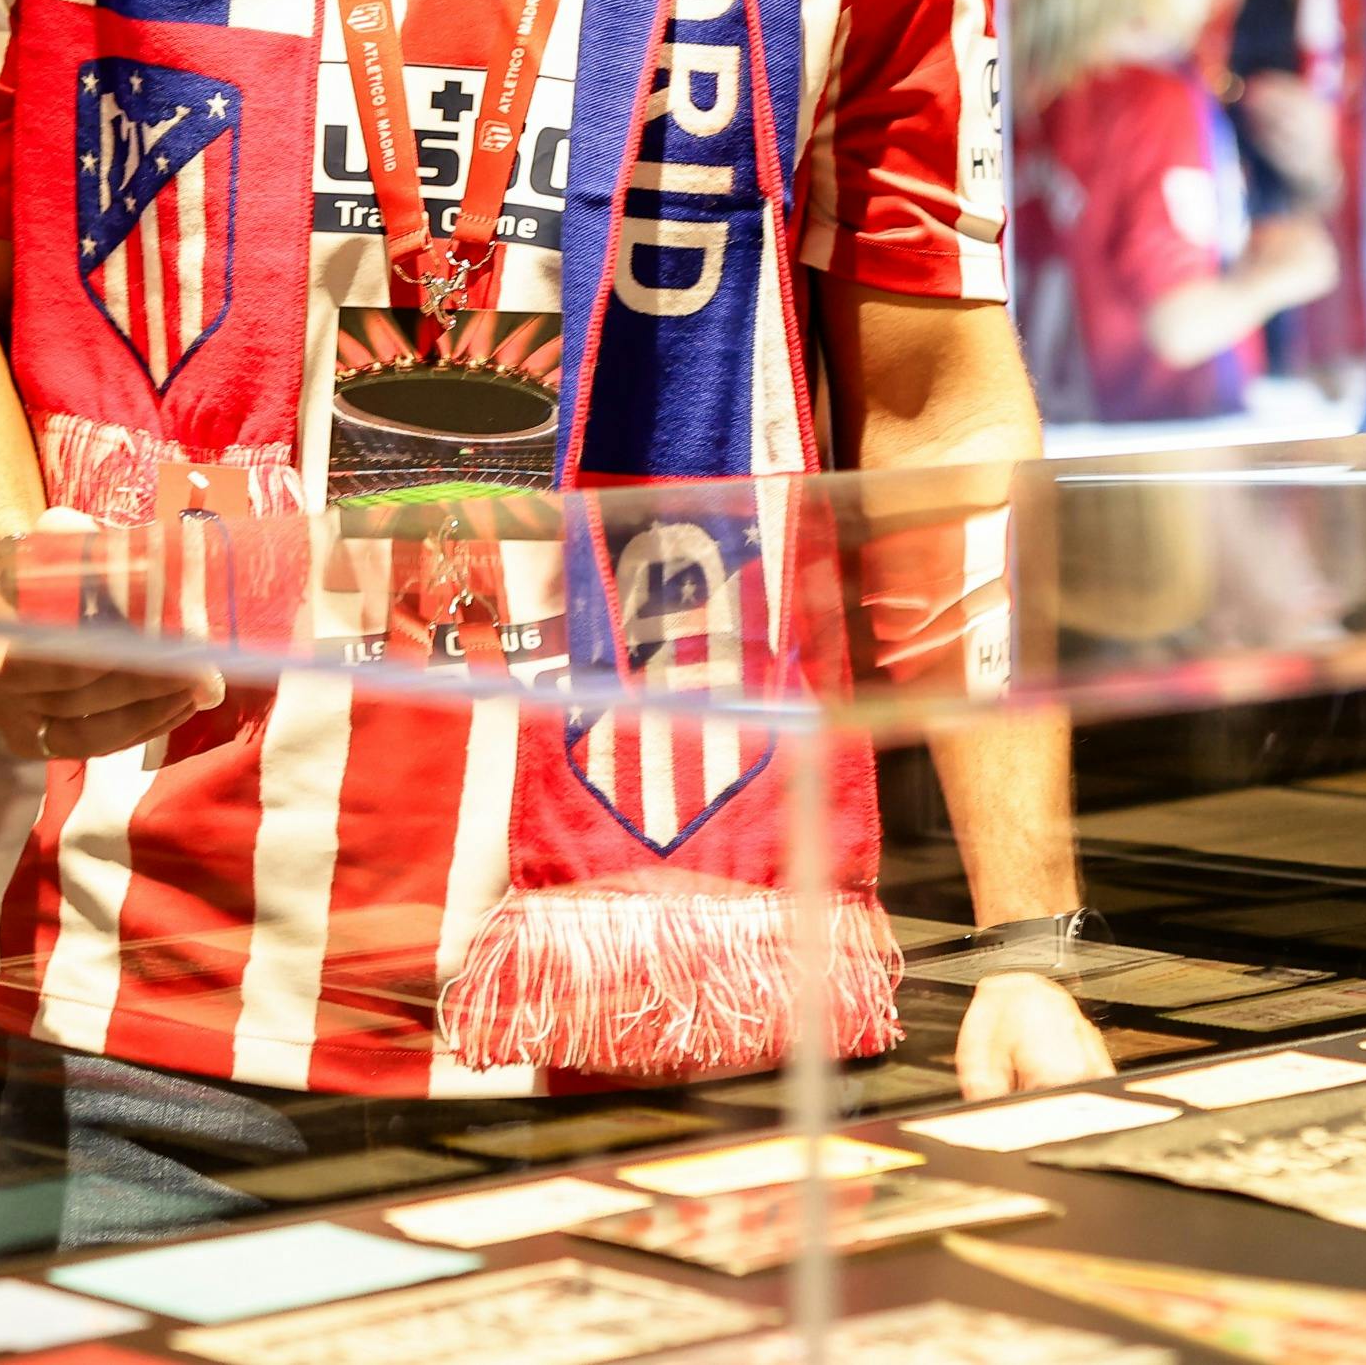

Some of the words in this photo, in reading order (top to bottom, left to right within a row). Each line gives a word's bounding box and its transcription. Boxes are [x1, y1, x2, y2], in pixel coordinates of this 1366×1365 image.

[362, 41, 387, 107] ATLETICO
[376, 118, 397, 173] MADRID
[497, 47, 526, 115] ATLETICO
